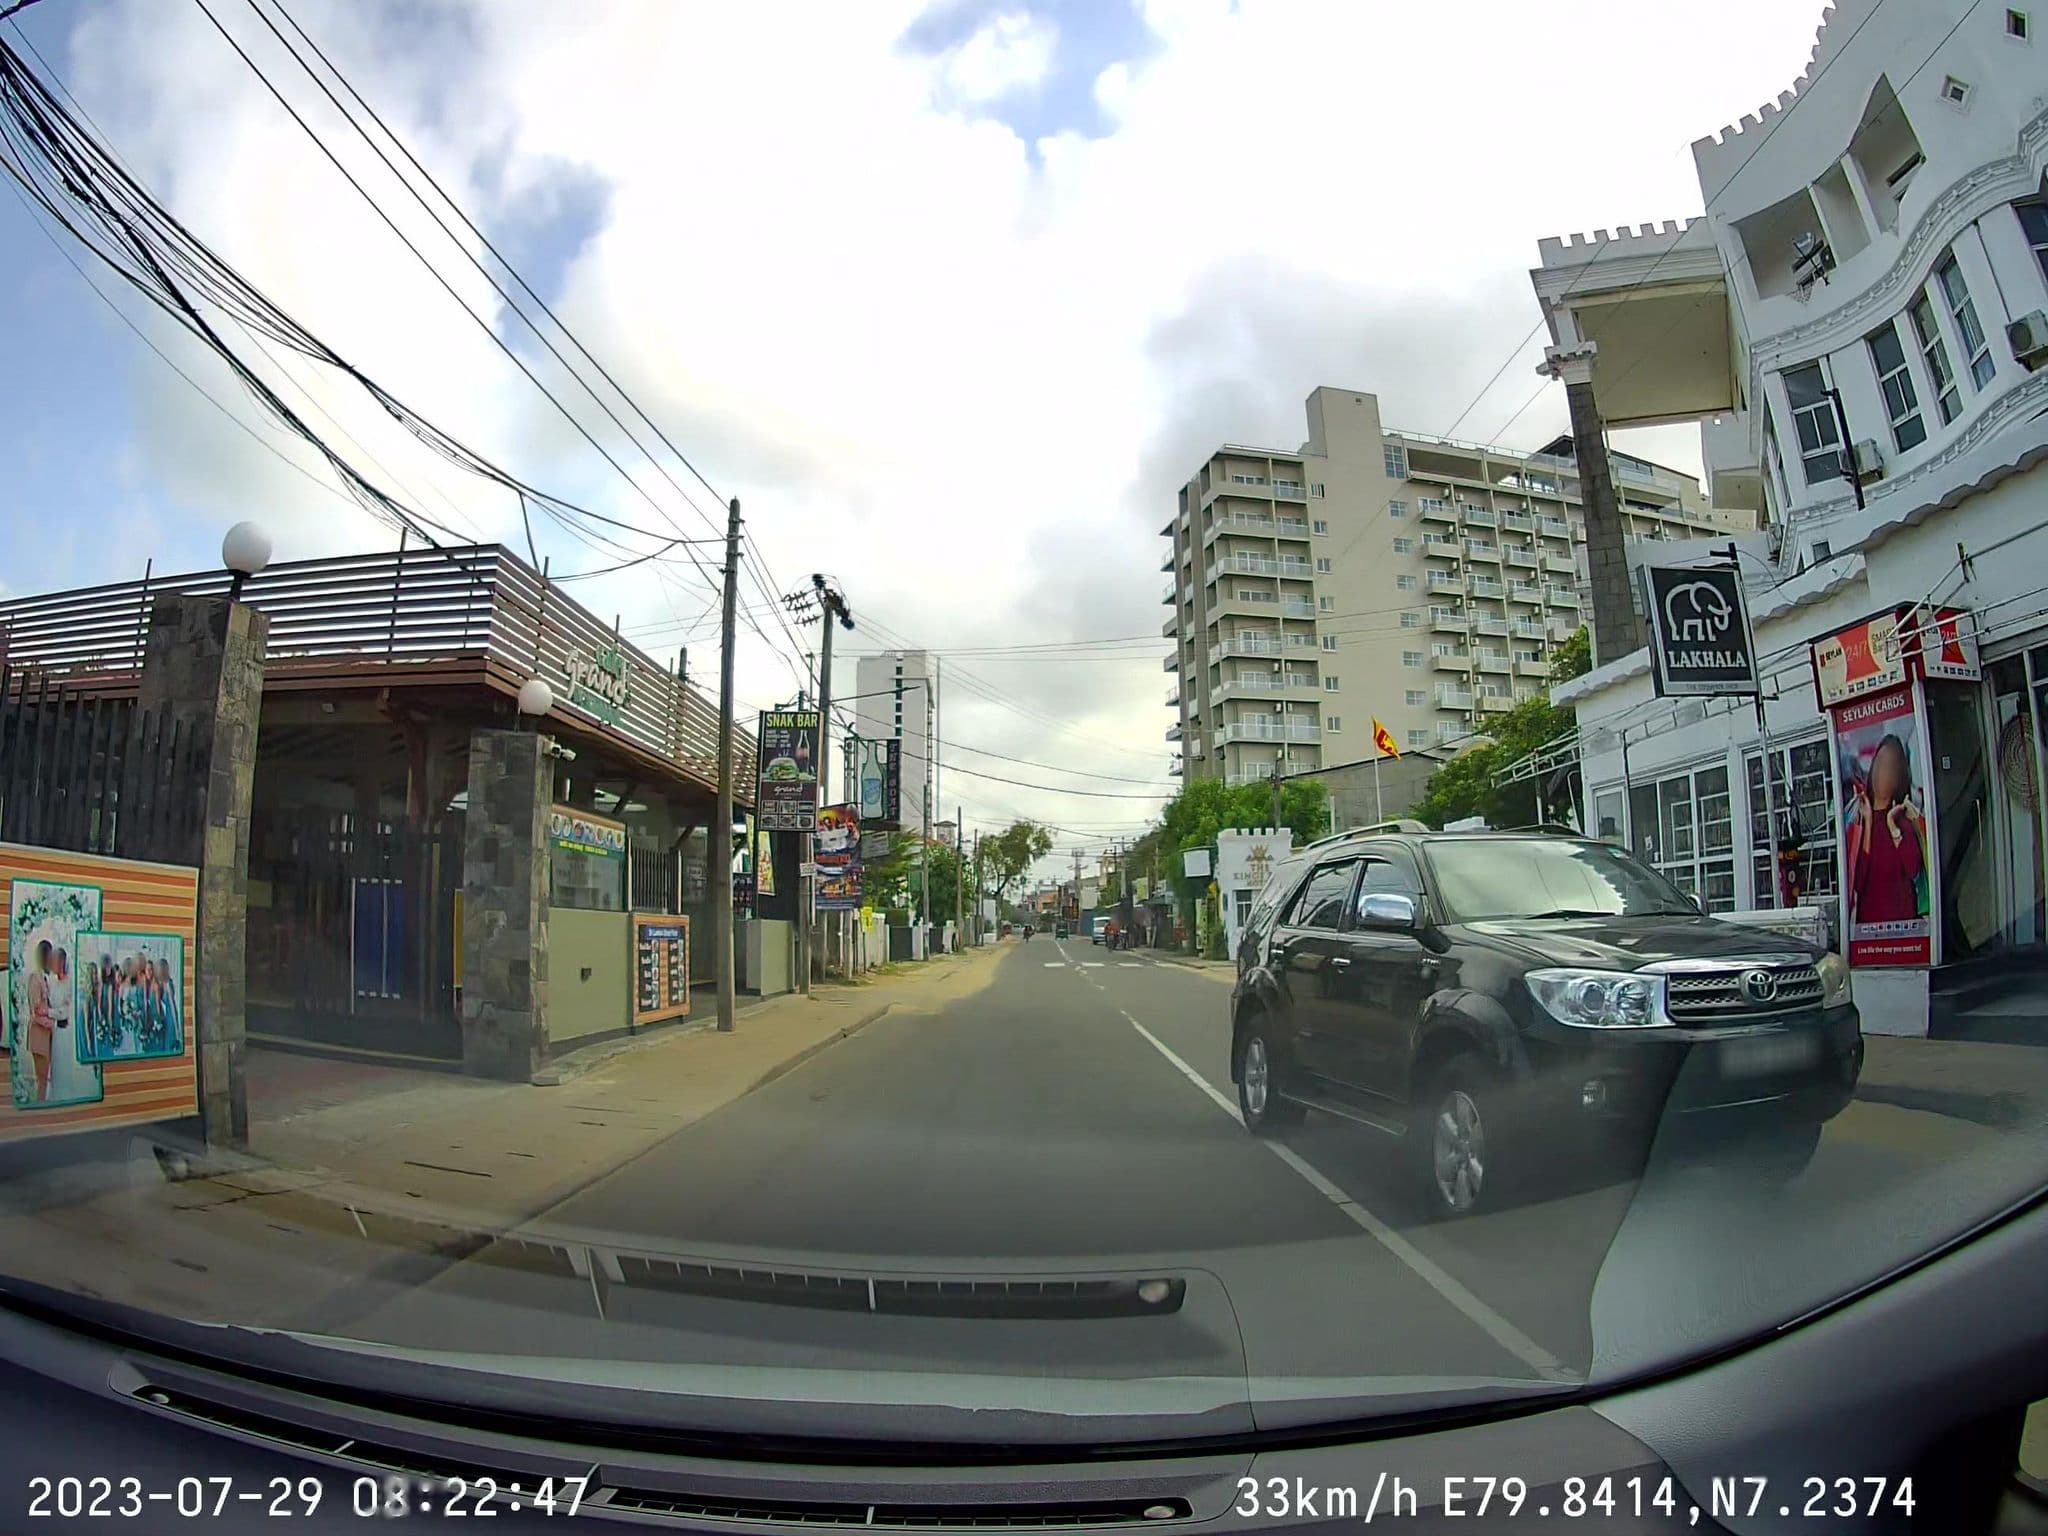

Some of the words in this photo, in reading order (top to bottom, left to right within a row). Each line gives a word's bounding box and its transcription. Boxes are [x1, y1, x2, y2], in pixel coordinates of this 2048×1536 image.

[1667, 650, 1747, 668] LAKHALA
[565, 649, 627, 705] grand
[1842, 703, 1875, 723] SEYLAN
[1875, 694, 1905, 713] CARDS
[766, 714, 794, 728] SNAK
[797, 714, 818, 728] BAR
[774, 783, 803, 796] grand
